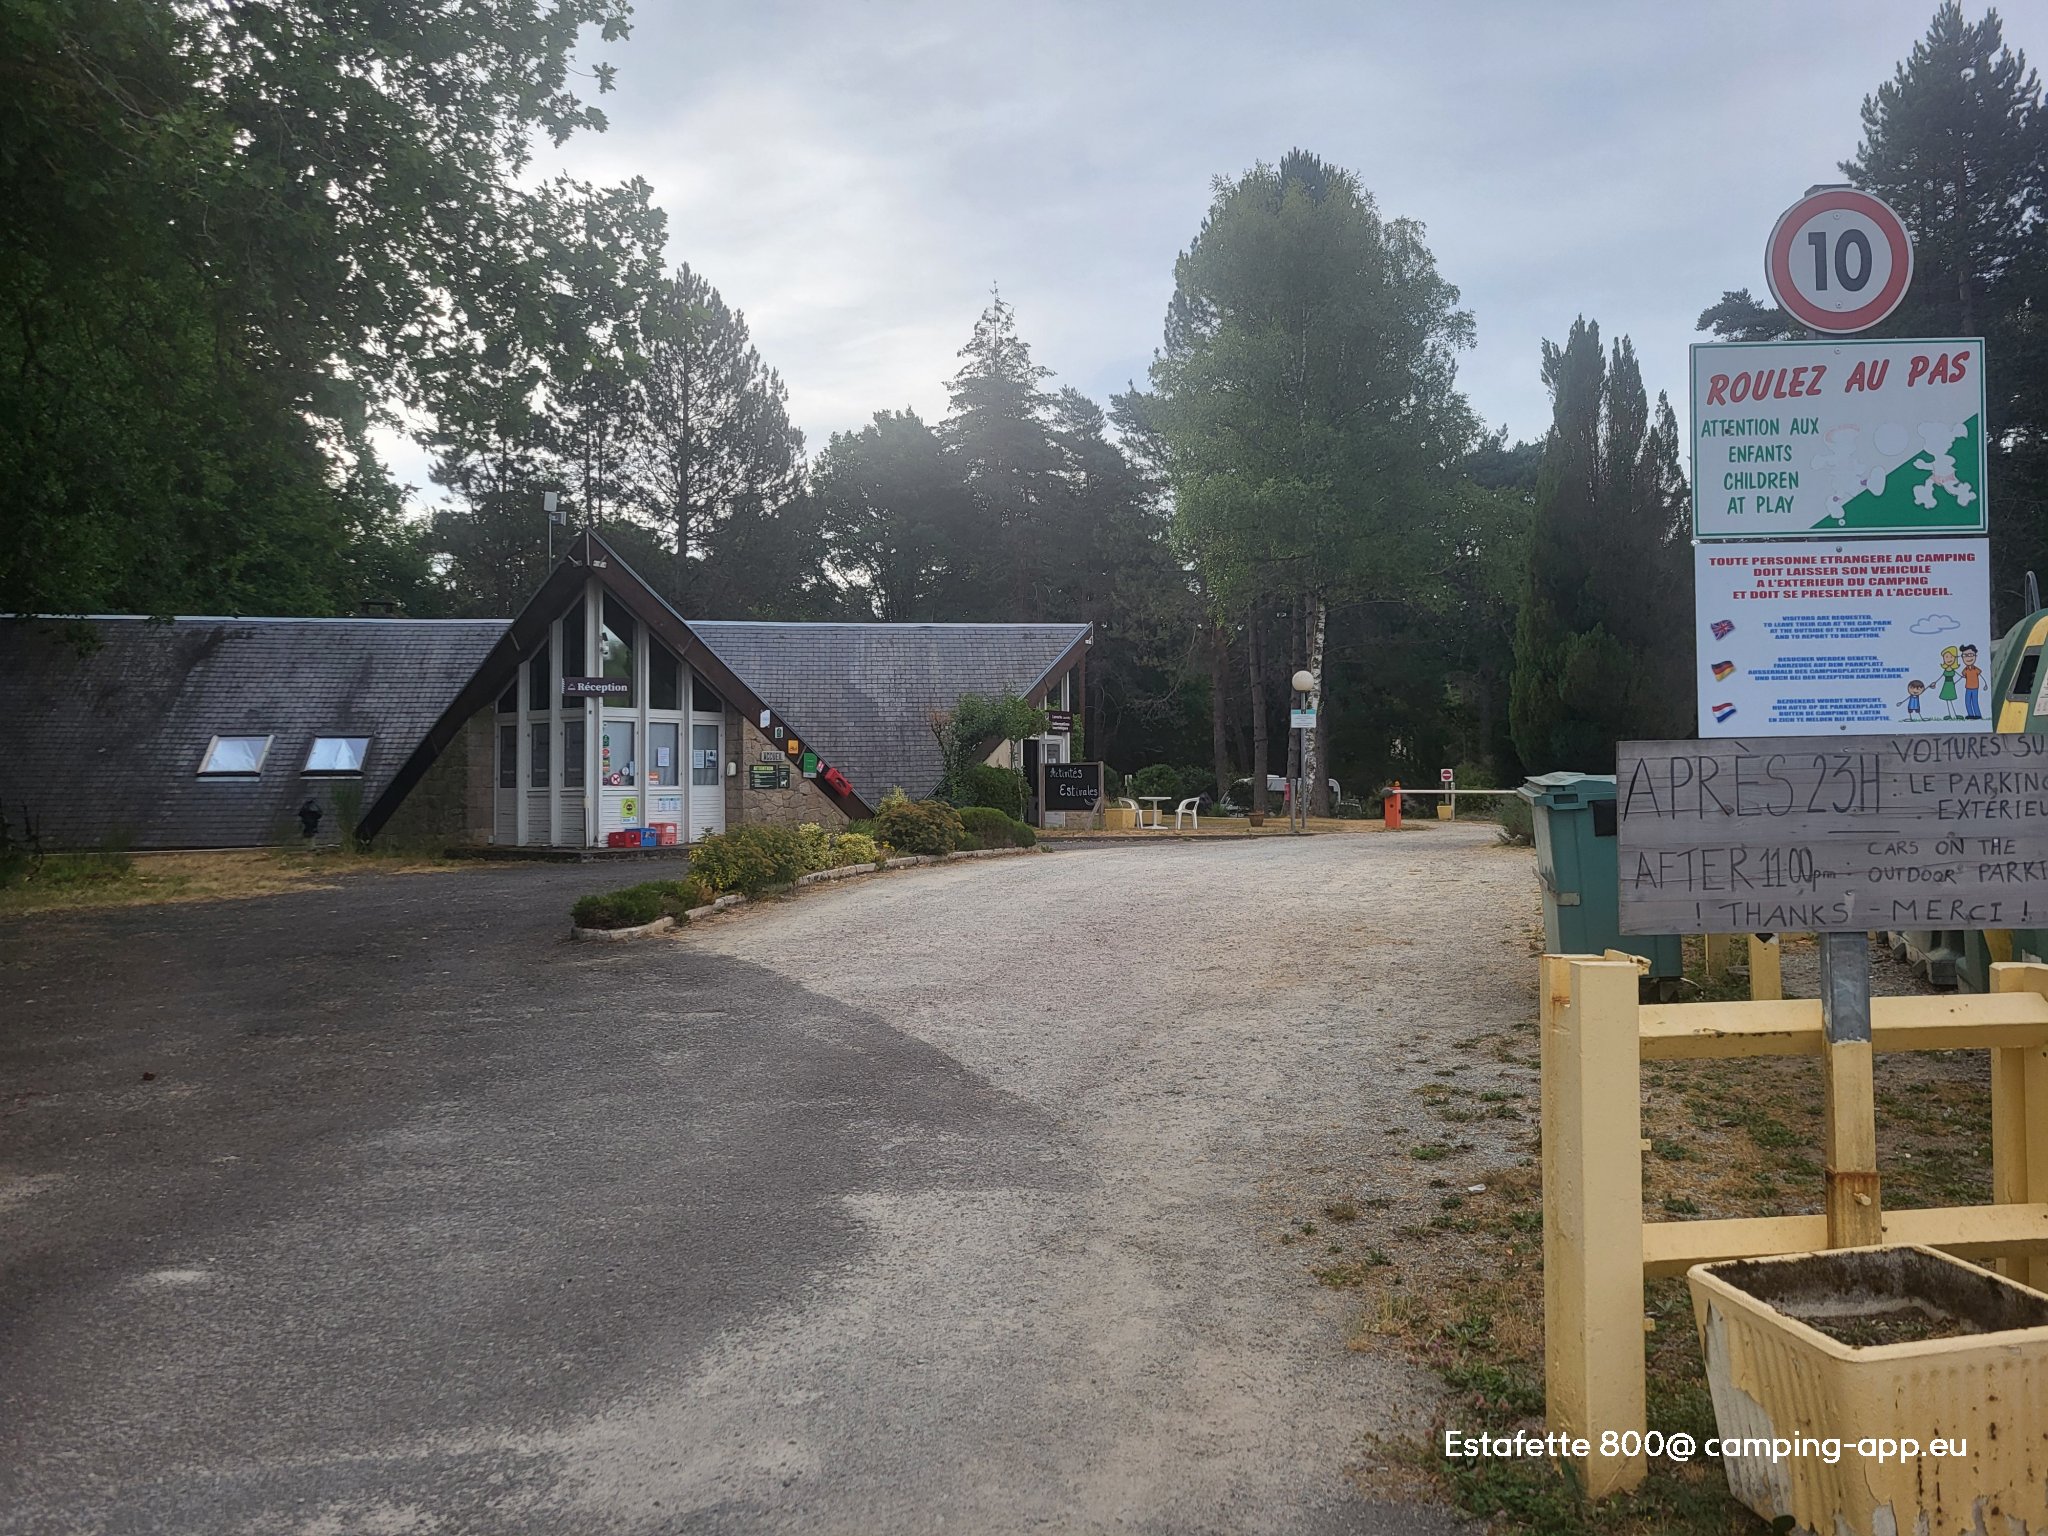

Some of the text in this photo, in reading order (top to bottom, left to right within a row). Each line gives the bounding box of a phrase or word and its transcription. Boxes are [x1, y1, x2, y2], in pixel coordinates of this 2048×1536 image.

[1808, 229, 1872, 292] 10
[1707, 351, 1970, 406] ROULEZ AU PAS
[1701, 417, 1819, 438] ATTENTION AUX
[1729, 444, 1792, 463] ENFANTS
[1724, 471, 1799, 490] CHILDREN
[1727, 495, 1794, 514] AT PLAY
[1709, 553, 1975, 566] TOUTE PERSONNE ETRANGERE AU CAMPING
[1753, 565, 1931, 577] DOIT LAISSER SON VEHICULE
[1757, 576, 1928, 588] A L'EXTERIEUR DU CAMPING
[1733, 587, 1952, 600] ET DOIT SE PRESENTER A L'ACCUEIL.
[578, 682, 628, 693] Réception
[1892, 736, 2000, 763] VOITURES
[1060, 783, 1098, 797] Estivales
[1624, 741, 1793, 821] APRÈS
[1910, 773, 1935, 794] LE
[1868, 838, 2016, 856] CARS ON THE
[1636, 848, 1754, 892] AFTER
[1869, 867, 1957, 885] OUTDOOR
[1718, 902, 1849, 927] THANKS
[1893, 899, 2002, 922] MERCI
